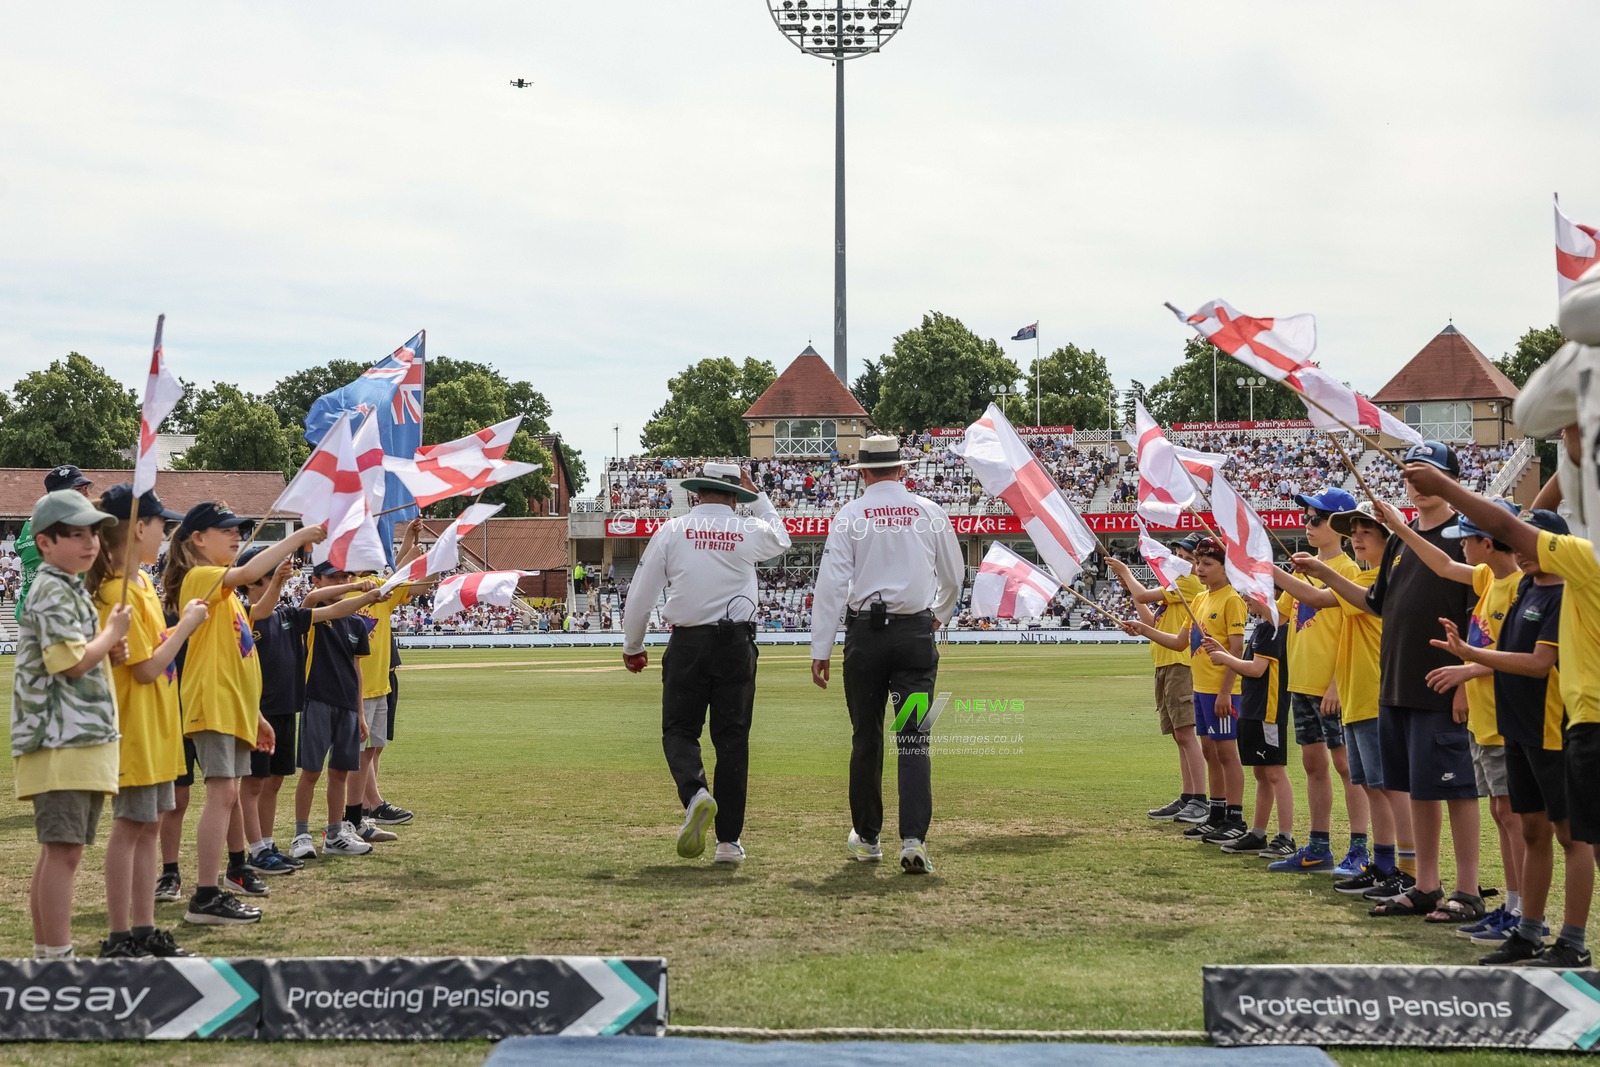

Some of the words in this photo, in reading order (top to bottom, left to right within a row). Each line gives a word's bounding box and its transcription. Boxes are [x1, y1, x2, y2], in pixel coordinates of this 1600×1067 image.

[1026, 426, 1039, 435] Pye
[1039, 425, 1065, 433] Auctions
[1181, 422, 1199, 430] John
[1200, 422, 1212, 430] Pye
[1213, 421, 1240, 429] Auctions
[1255, 421, 1272, 429] John
[1273, 421, 1285, 429] Pye
[939, 428, 956, 436] John
[863, 504, 920, 519] Emirates
[685, 528, 744, 542] Emirates
[694, 540, 708, 551] FLY
[708, 541, 736, 552] BETTER
[287, 986, 424, 1014] Protecting
[432, 984, 551, 1009] Pensions
[1238, 994, 1380, 1021] Protecting
[1388, 994, 1513, 1019] Pensions
